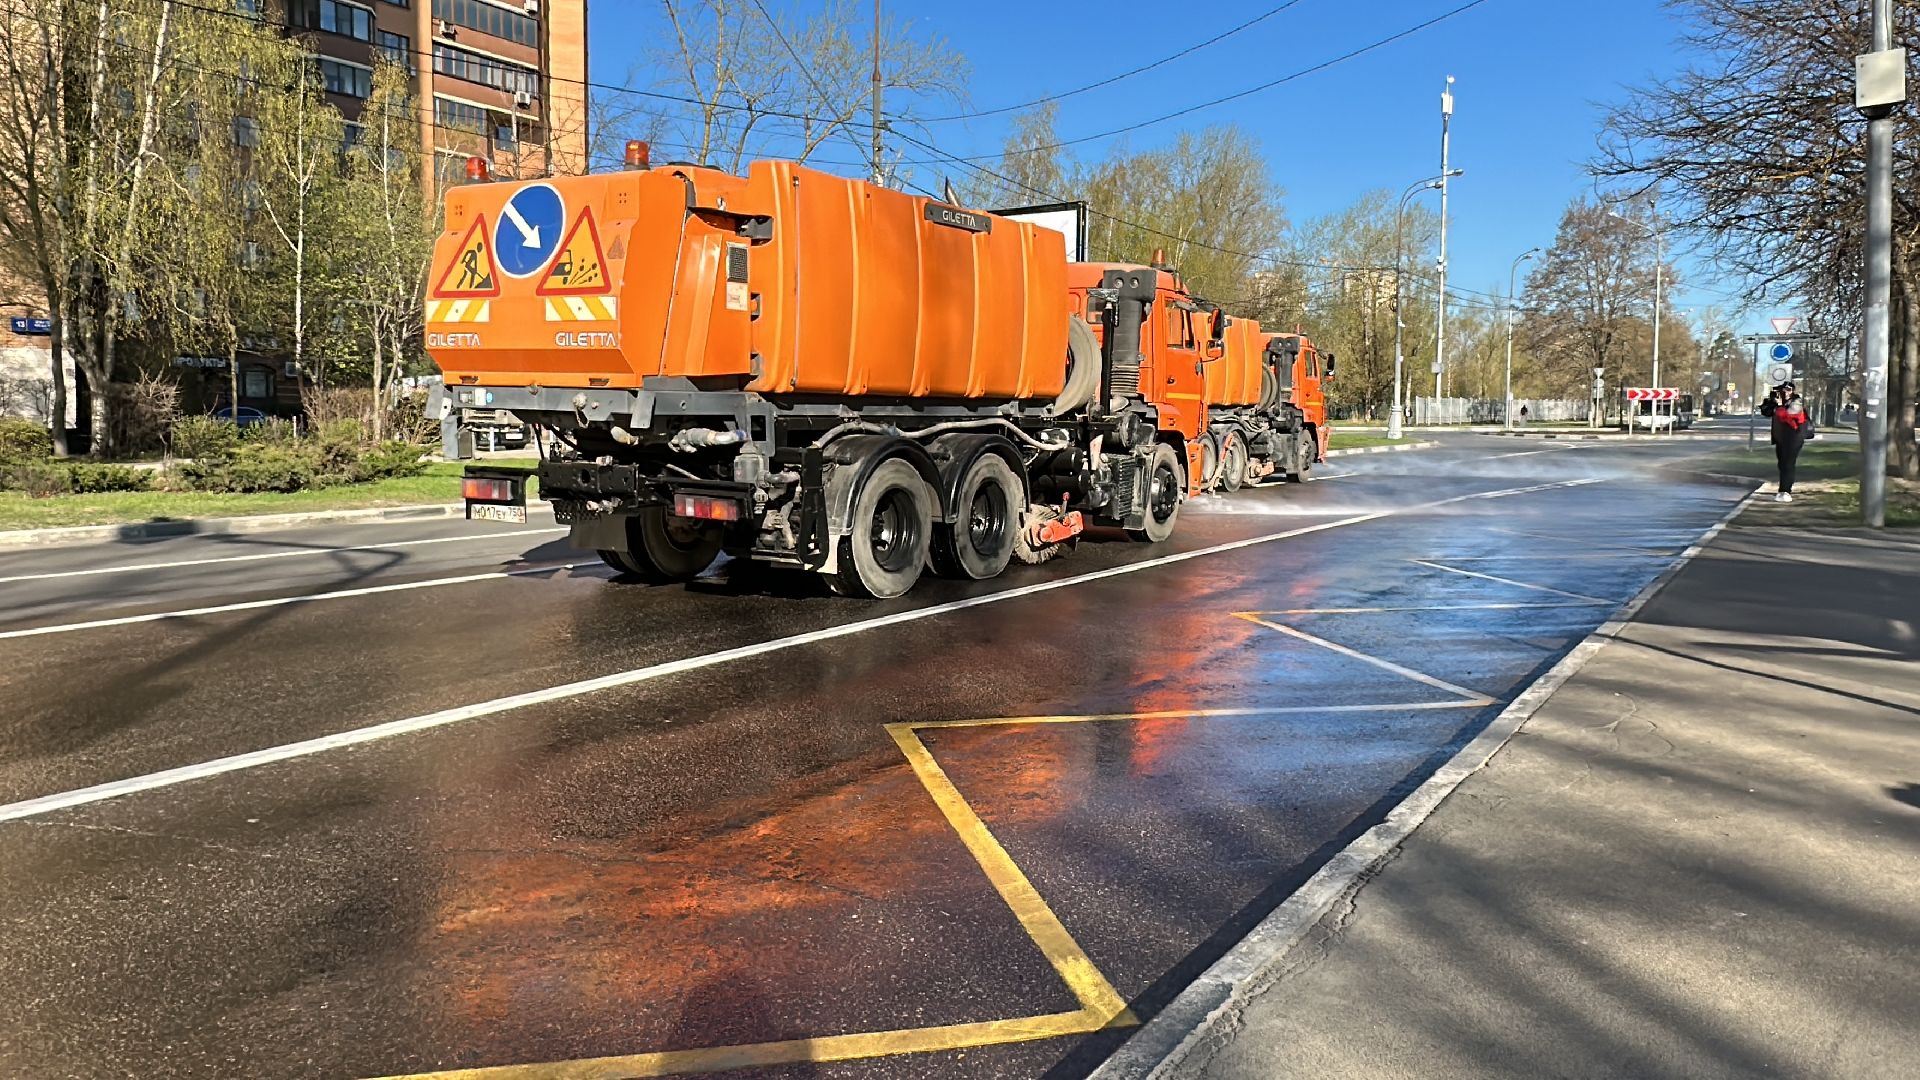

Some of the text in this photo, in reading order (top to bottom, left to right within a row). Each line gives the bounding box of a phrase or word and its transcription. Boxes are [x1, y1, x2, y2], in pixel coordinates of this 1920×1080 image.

[942, 210, 976, 227] GILETTA
[428, 333, 481, 347] GILETTA
[555, 332, 617, 347] GILETTA
